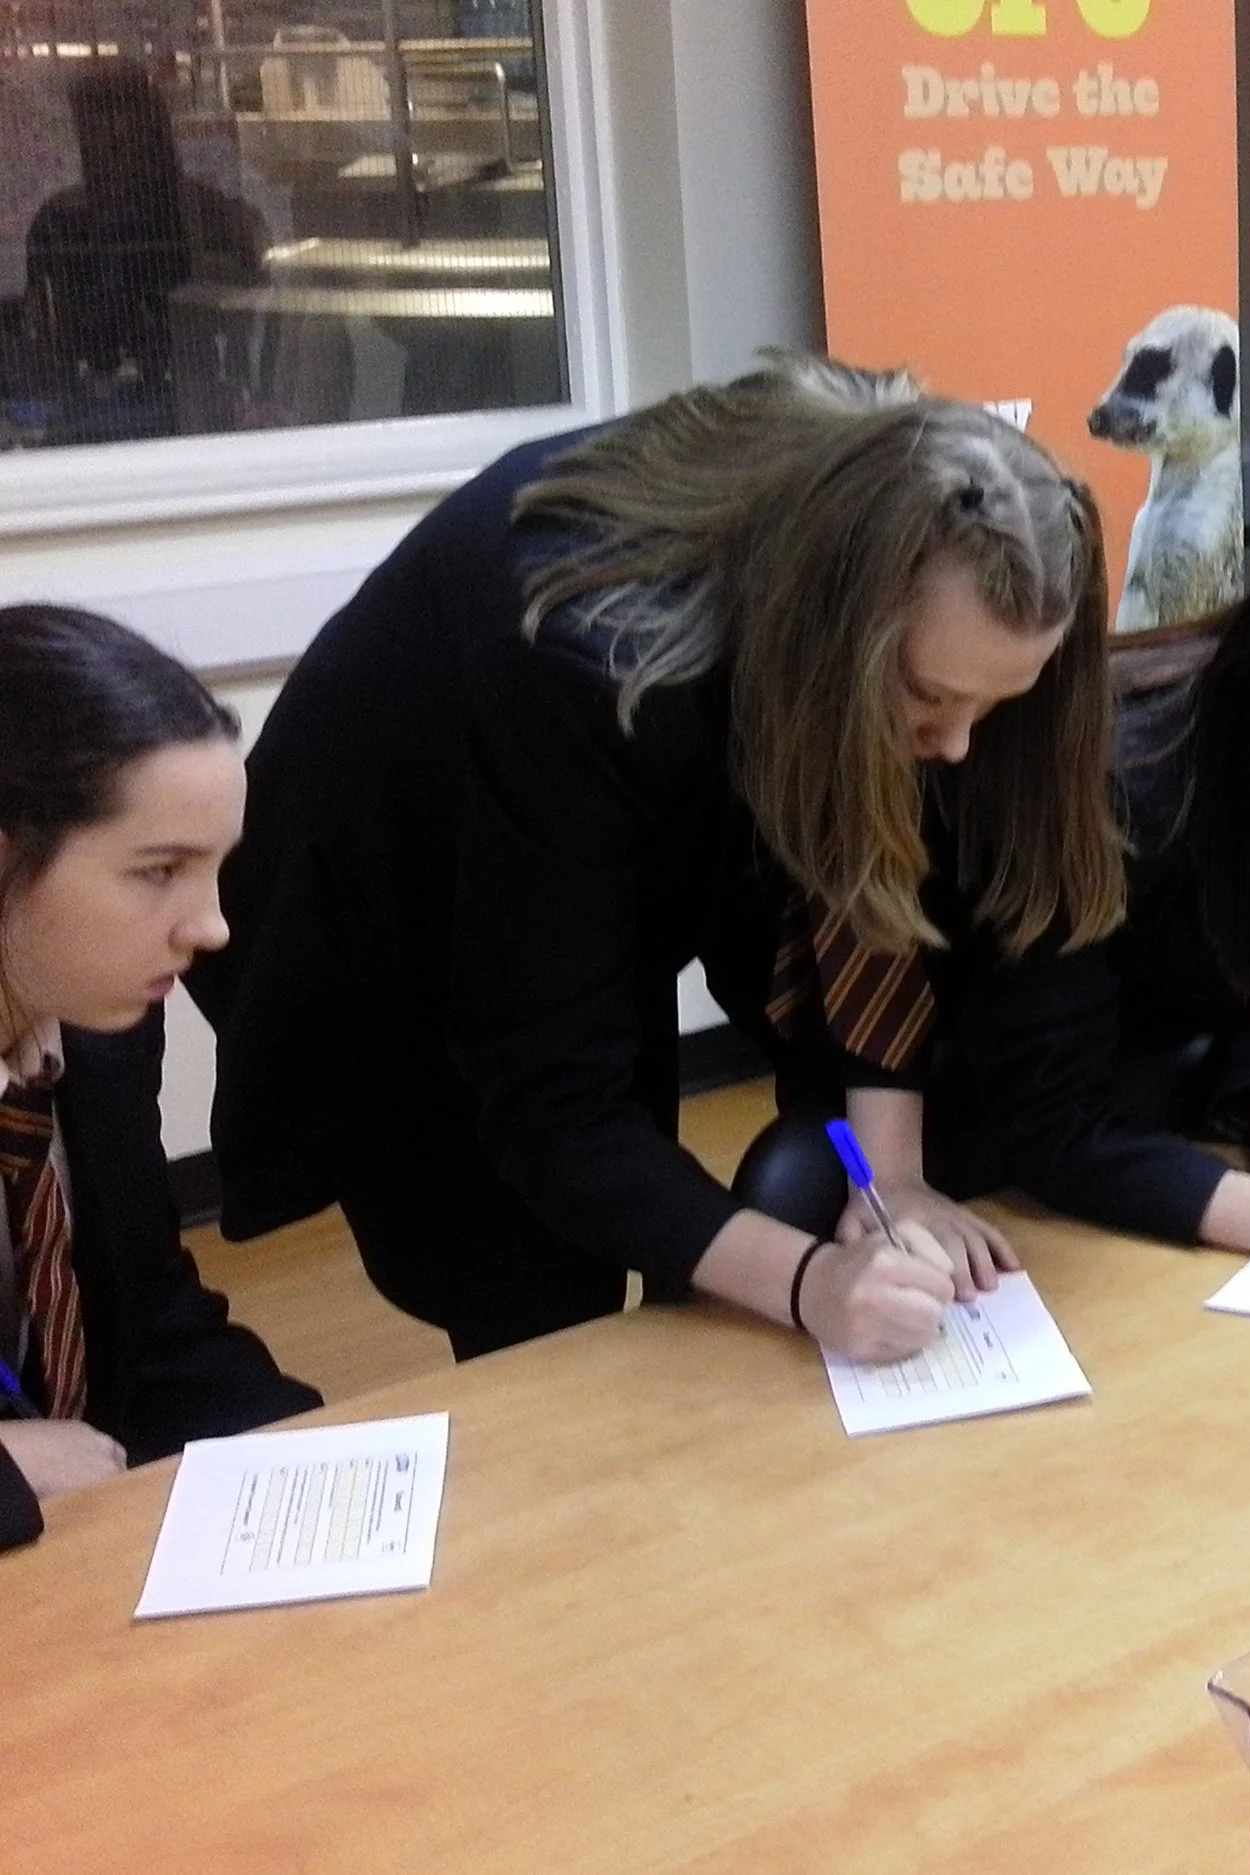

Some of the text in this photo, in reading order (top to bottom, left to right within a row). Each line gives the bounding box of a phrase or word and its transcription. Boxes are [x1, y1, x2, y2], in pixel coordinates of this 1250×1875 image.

[901, 61, 1160, 119] Drive the
[898, 146, 1169, 210] Safe Way
